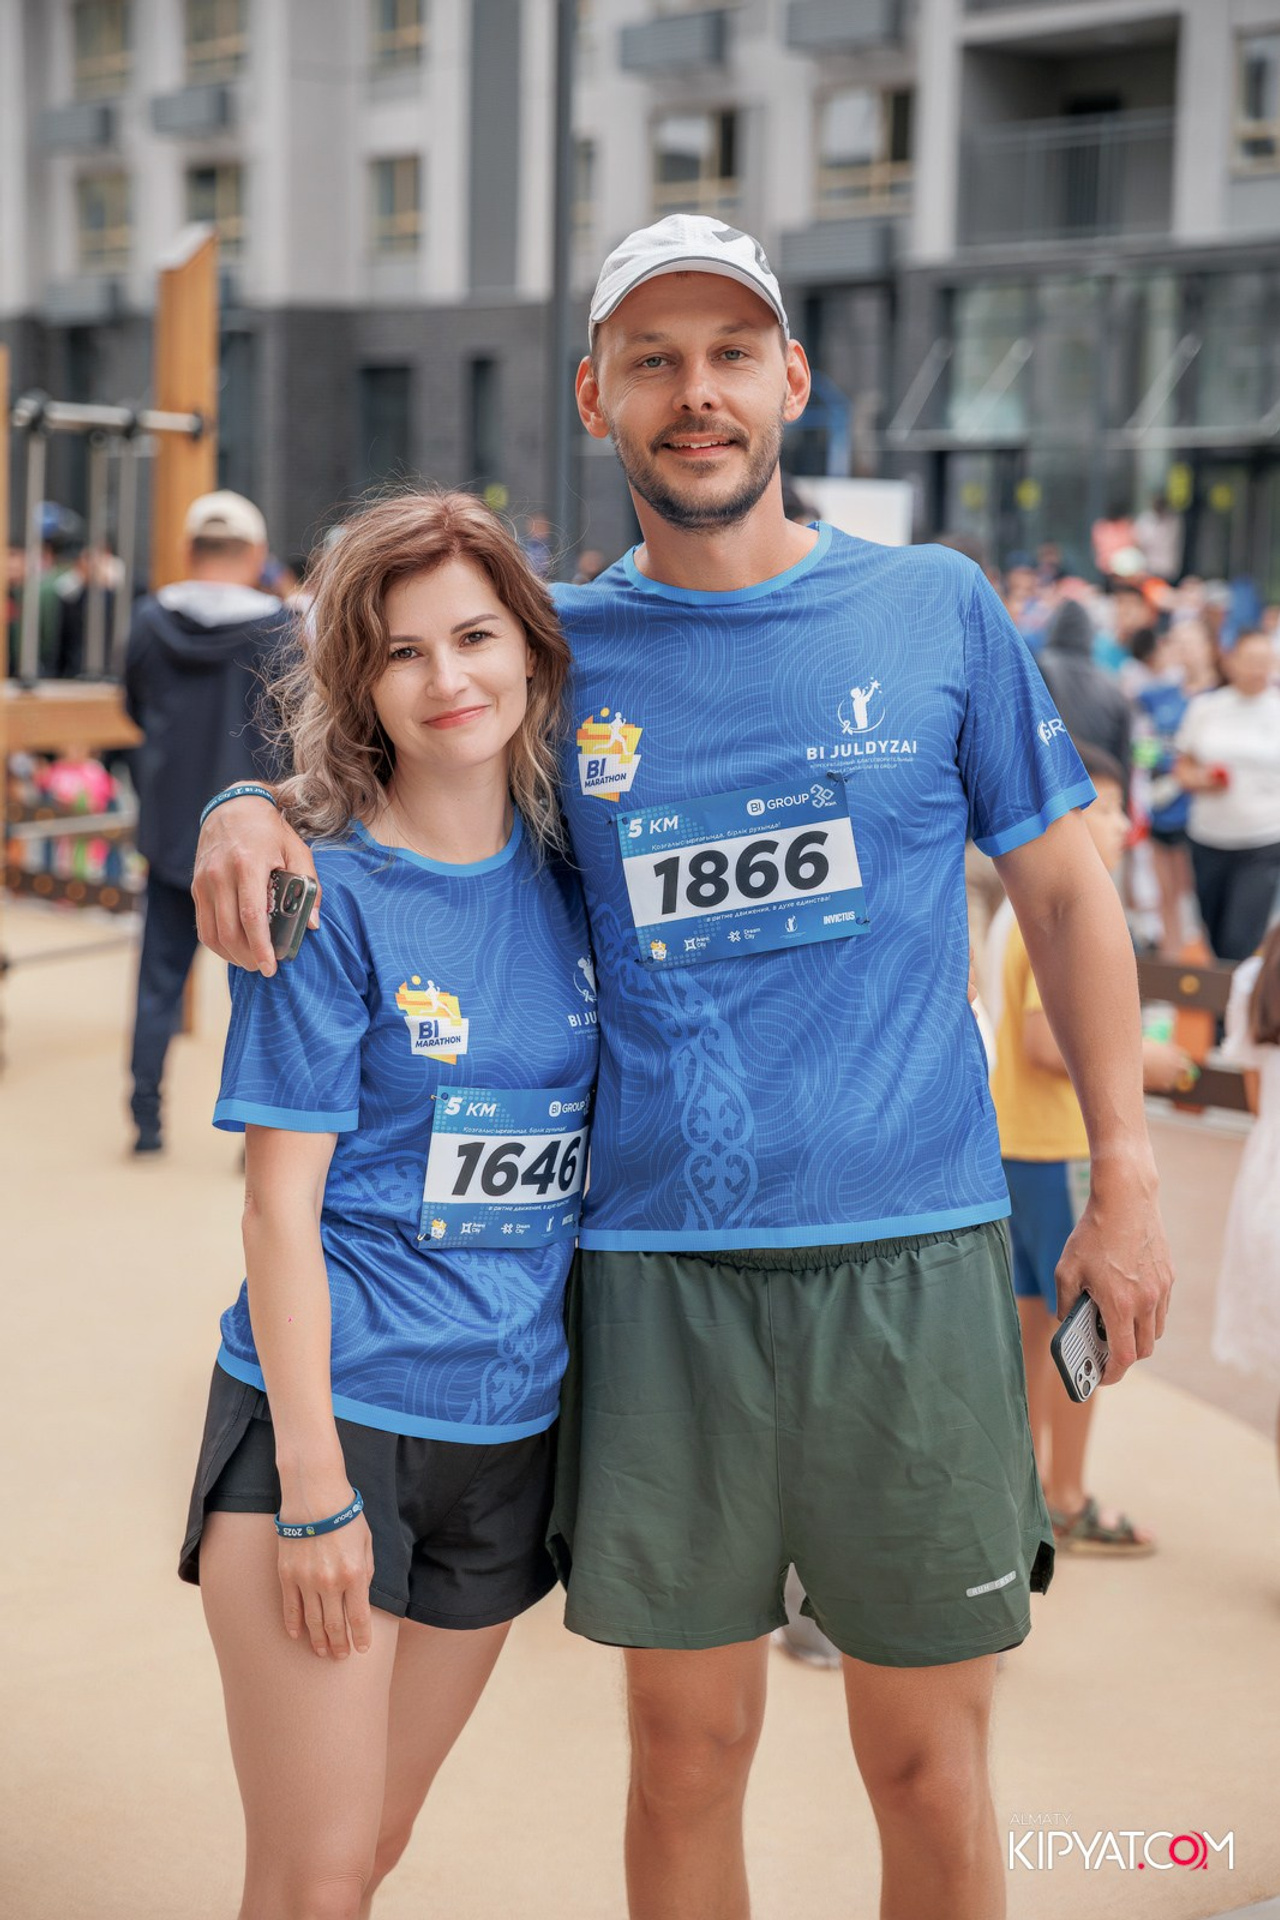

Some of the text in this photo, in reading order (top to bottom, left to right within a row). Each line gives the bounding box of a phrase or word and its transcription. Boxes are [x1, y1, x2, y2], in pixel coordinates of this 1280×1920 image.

[806, 740, 917, 760] BI JULDYZAI
[586, 758, 607, 780] BI
[584, 773, 627, 788] MARATHON
[767, 793, 809, 810] GROUP
[627, 815, 679, 839] 5 KM
[653, 831, 829, 916] 1866
[823, 911, 855, 926] INVICTUS
[418, 1019, 440, 1040] BI
[567, 1014, 582, 1027] BI
[415, 1035, 461, 1049] MARATHON
[444, 1096, 497, 1118] 5 KM
[562, 1101, 586, 1114] GROUP
[451, 1136, 582, 1197] 1646
[282, 1527, 303, 1537] 2025
